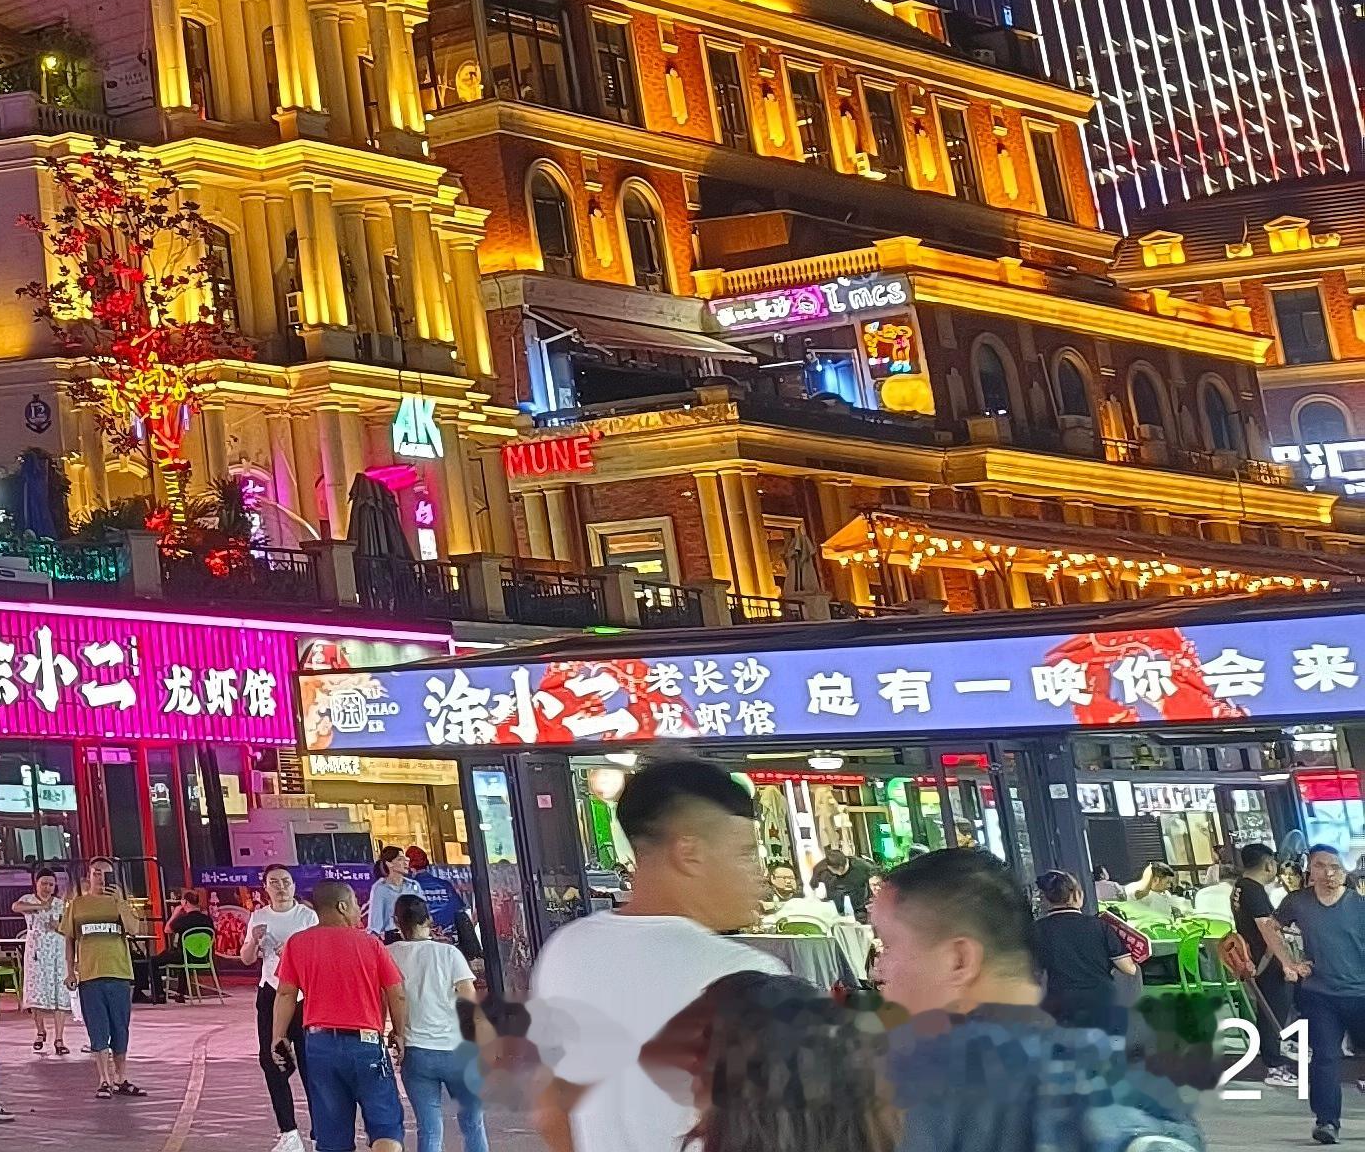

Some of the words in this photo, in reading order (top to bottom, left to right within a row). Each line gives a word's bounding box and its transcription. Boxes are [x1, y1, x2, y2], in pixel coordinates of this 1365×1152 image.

[164, 664, 277, 718] 龙虾馆
[646, 658, 771, 697] 老长沙
[807, 642, 1361, 717] 总有一晚你会来
[424, 666, 639, 745] 涂小二
[652, 700, 776, 737] 龙虾馆
